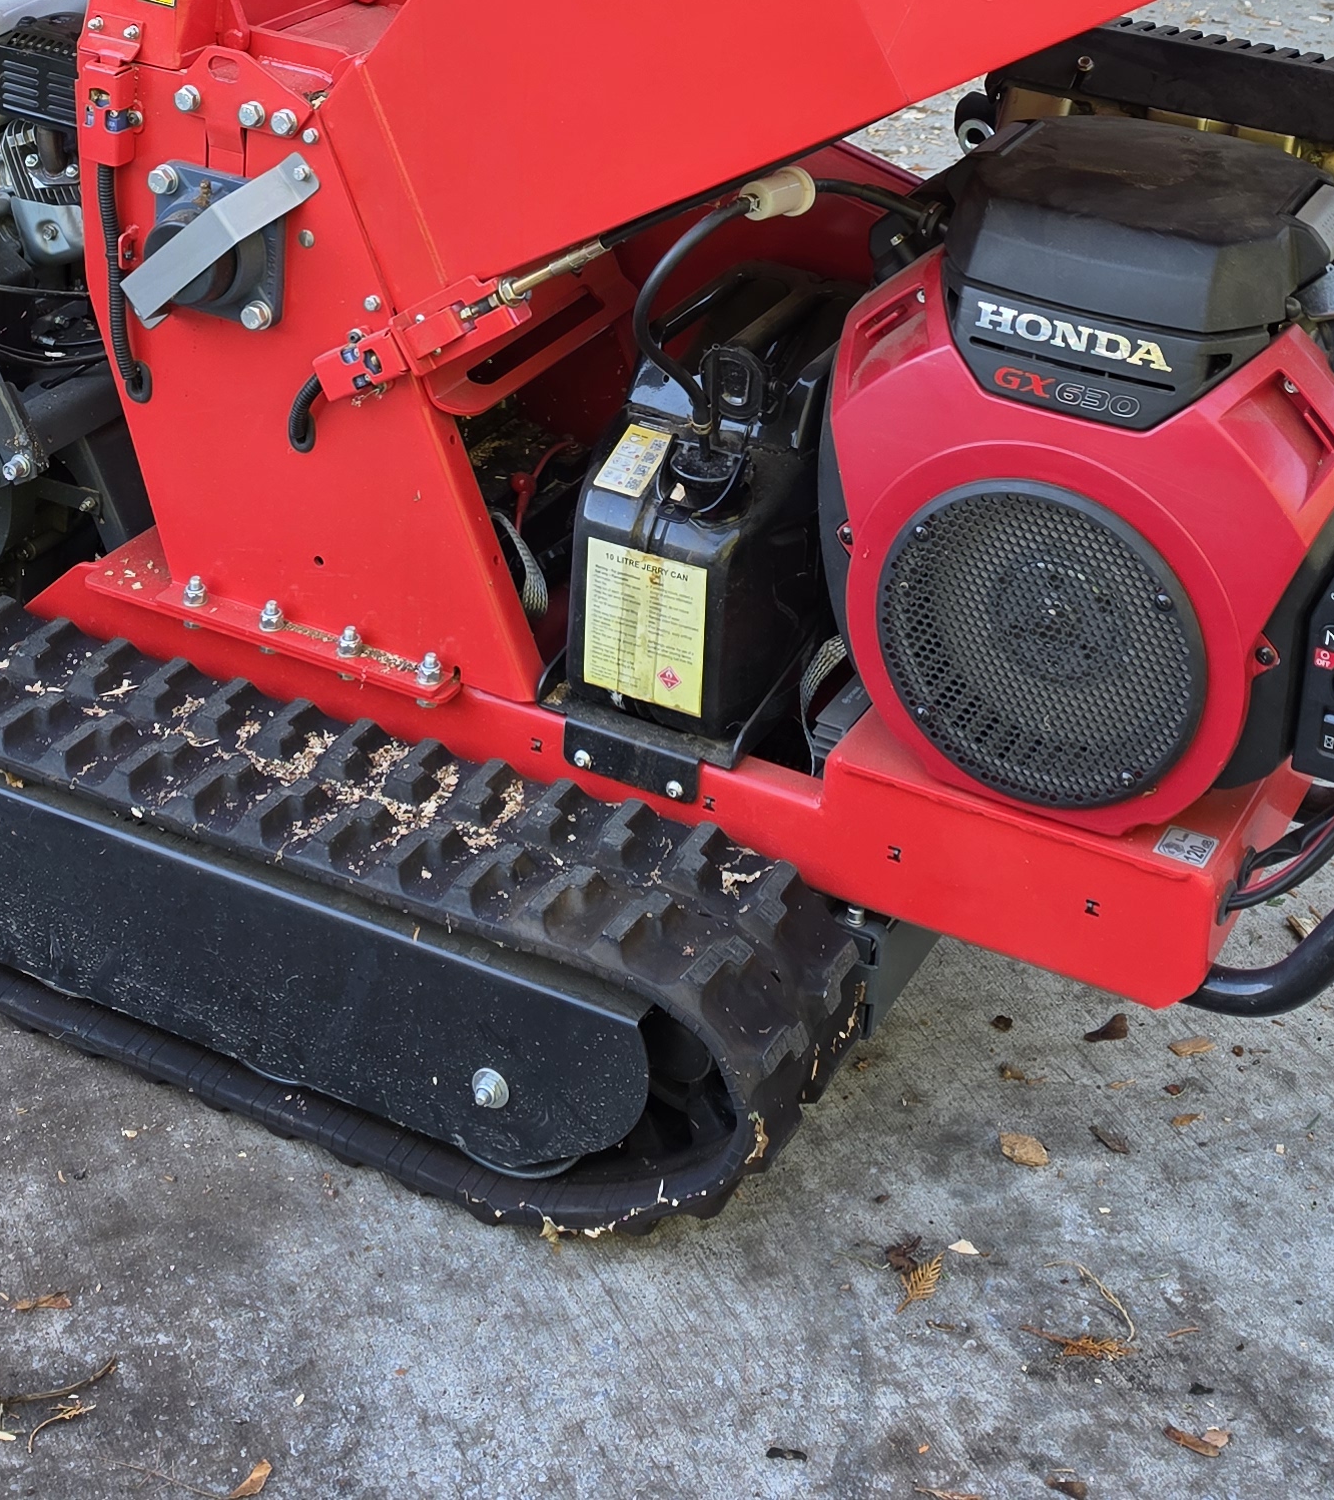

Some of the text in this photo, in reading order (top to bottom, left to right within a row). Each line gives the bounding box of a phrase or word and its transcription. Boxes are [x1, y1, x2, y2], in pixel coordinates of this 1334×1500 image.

[974, 301, 1173, 373] HONDA
[993, 366, 1140, 418] GX630
[605, 552, 689, 582] 10 LITRE JERRY CAN
[1316, 658, 1331, 667] OFF
[1184, 845, 1206, 862] 120
